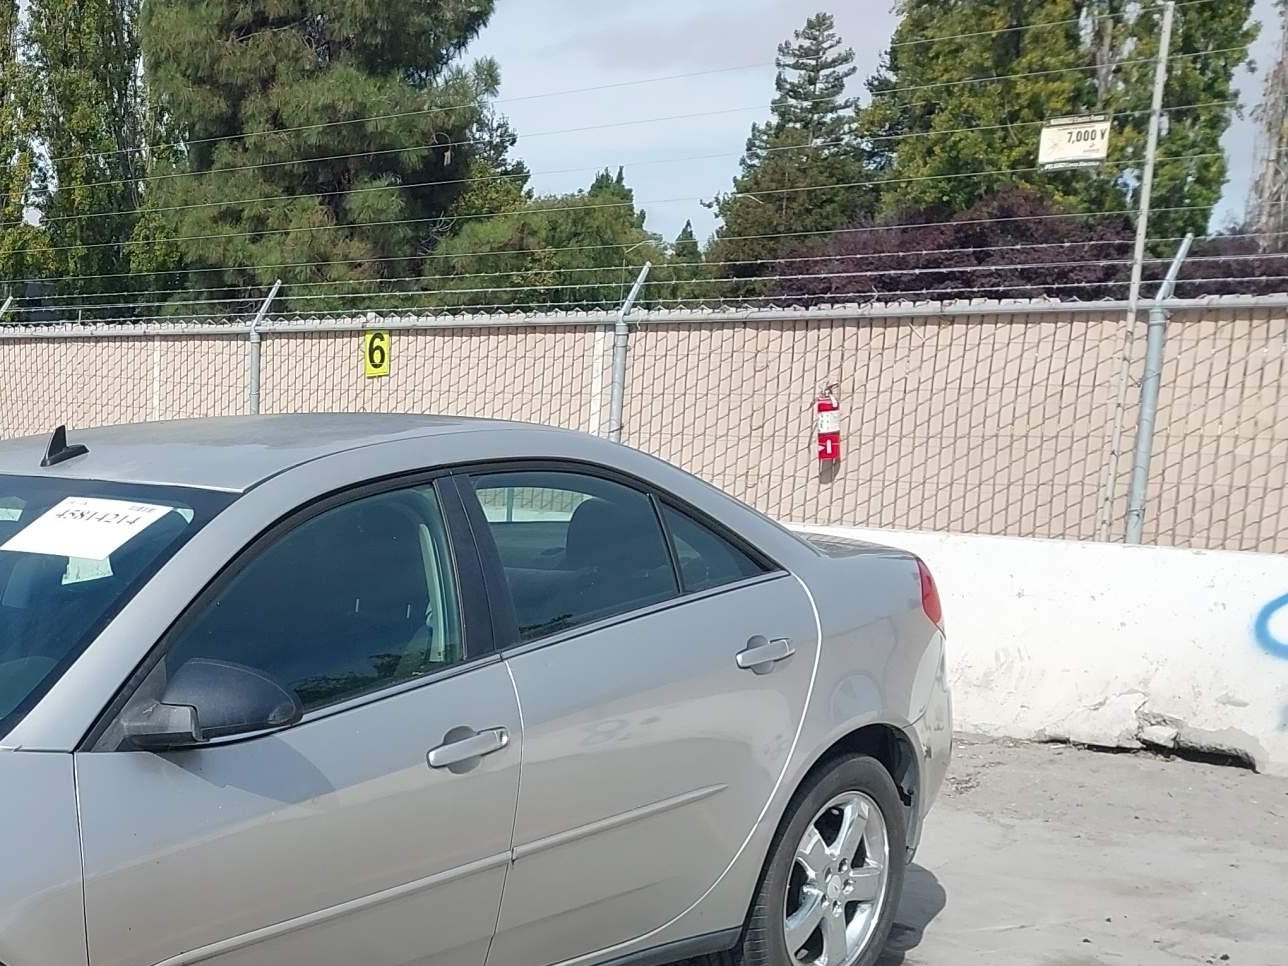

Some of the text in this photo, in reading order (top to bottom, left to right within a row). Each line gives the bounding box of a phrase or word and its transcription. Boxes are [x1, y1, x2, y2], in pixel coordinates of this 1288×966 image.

[1067, 130, 1097, 144] 7,000
[368, 332, 386, 369] 6
[55, 509, 141, 525] 45814214
